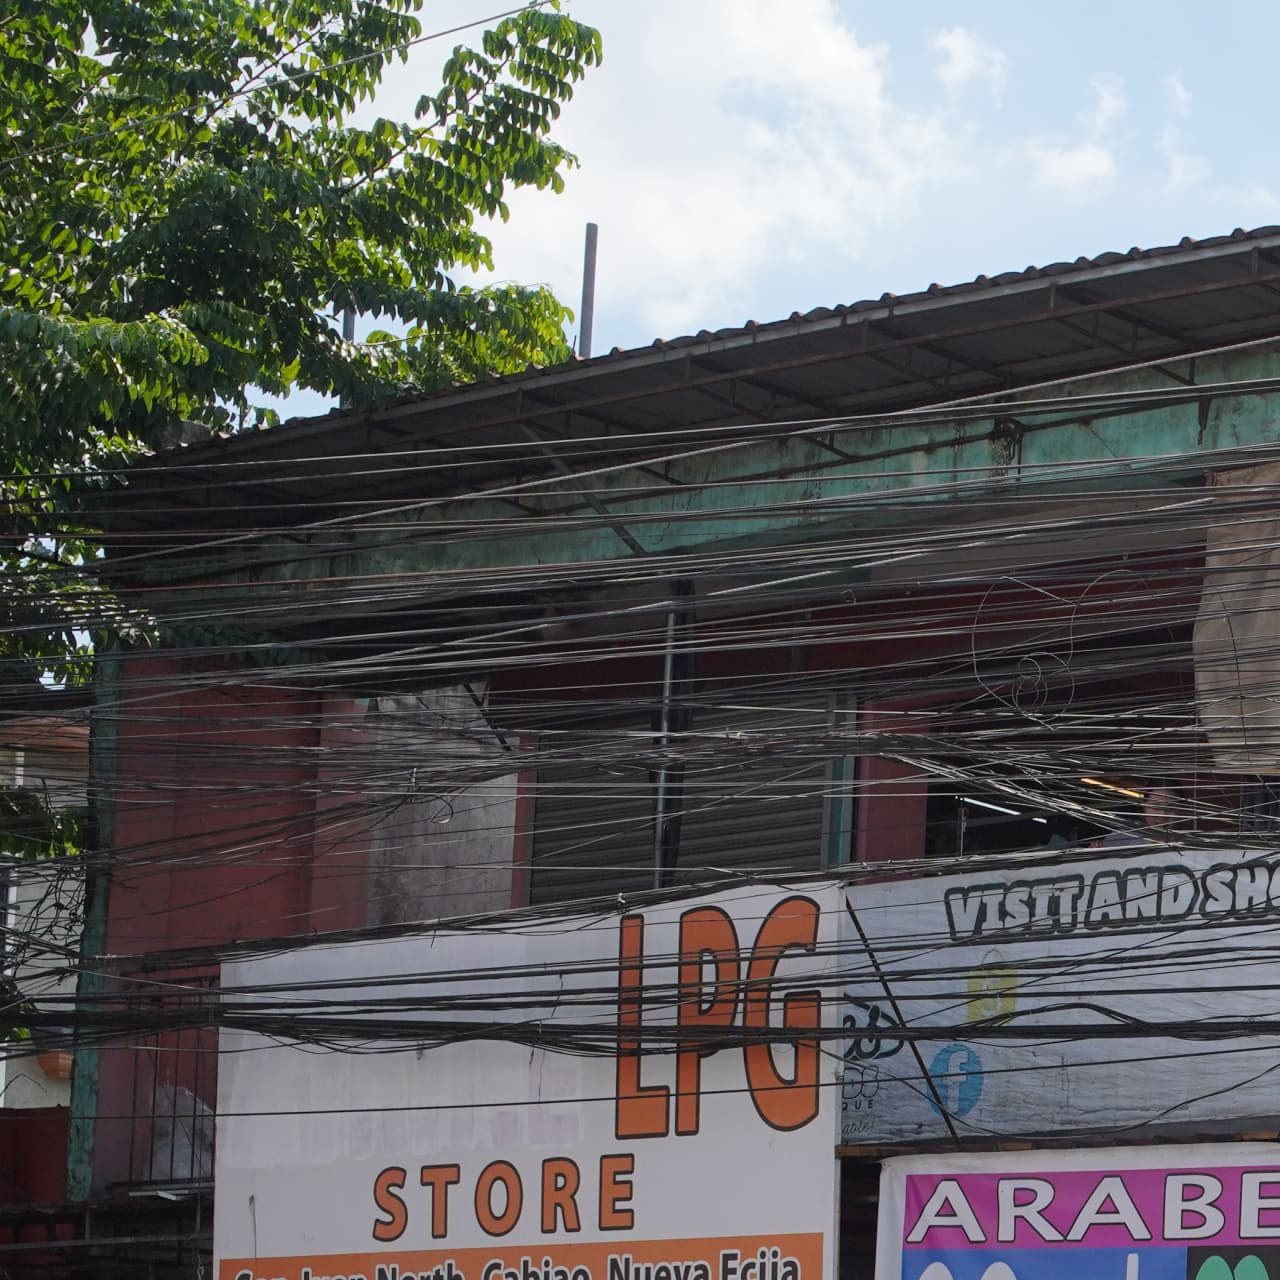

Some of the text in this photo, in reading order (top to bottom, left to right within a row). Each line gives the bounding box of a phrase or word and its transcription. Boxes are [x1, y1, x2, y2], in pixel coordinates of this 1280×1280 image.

[945, 874, 1085, 942] VISIT
[1084, 865, 1200, 930] AND
[616, 895, 821, 1139] LPG
[372, 1153, 635, 1242] STORE
